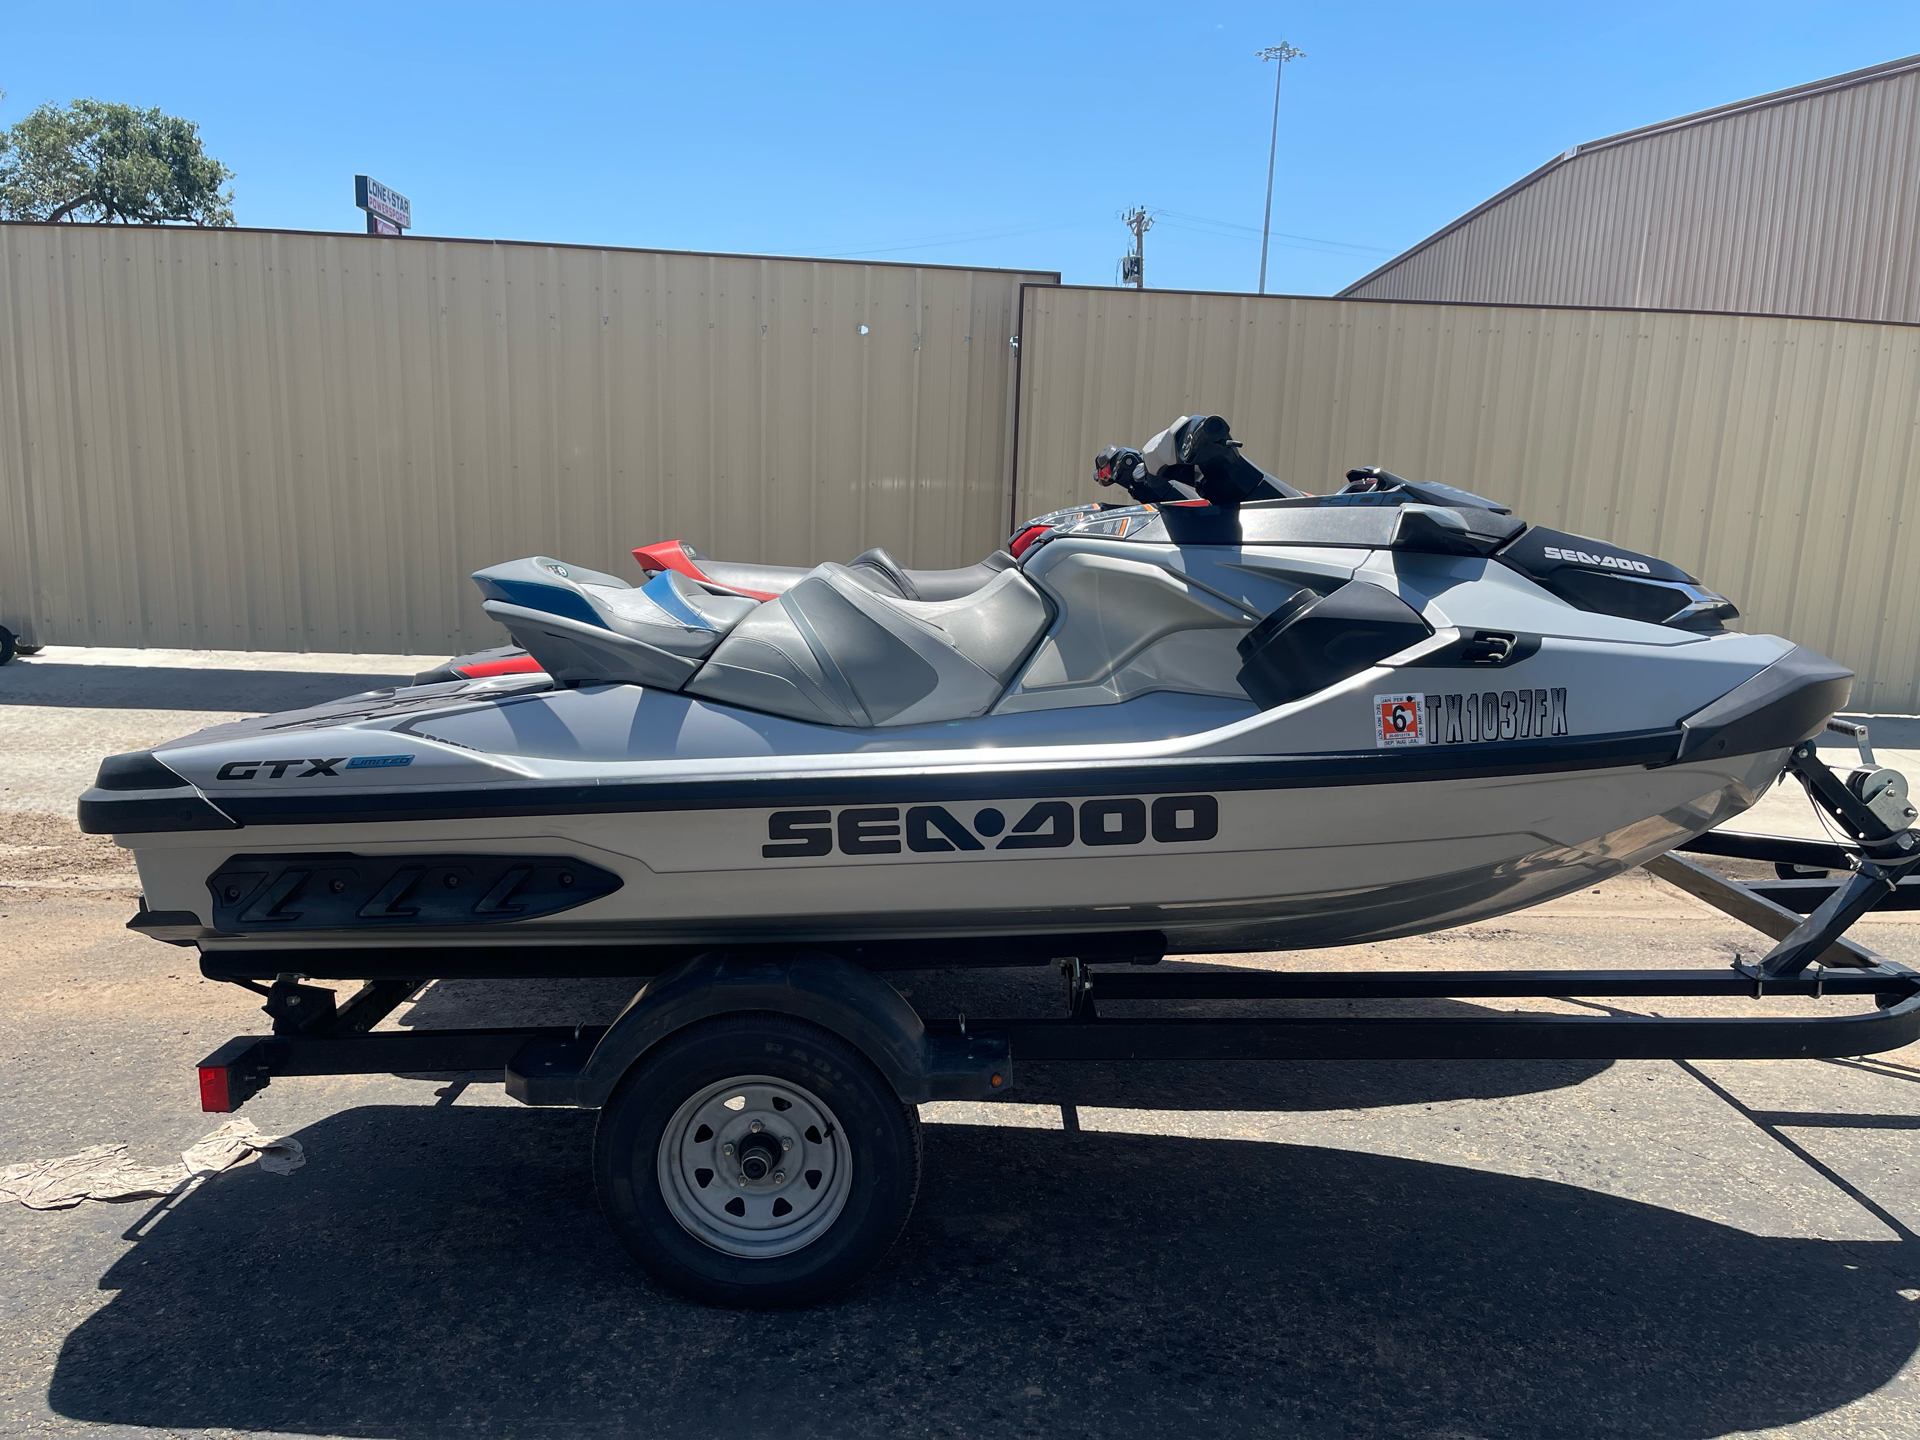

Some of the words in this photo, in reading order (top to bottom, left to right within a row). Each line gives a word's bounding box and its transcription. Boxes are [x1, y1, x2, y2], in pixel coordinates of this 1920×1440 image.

[368, 179, 387, 203] LONE
[391, 193, 409, 215] STAR
[368, 196, 409, 226] POWERSPORTS
[1319, 493, 1414, 507] 300
[1392, 705, 1407, 732] 6
[216, 757, 348, 781] GTX
[350, 756, 410, 766] LIMITED
